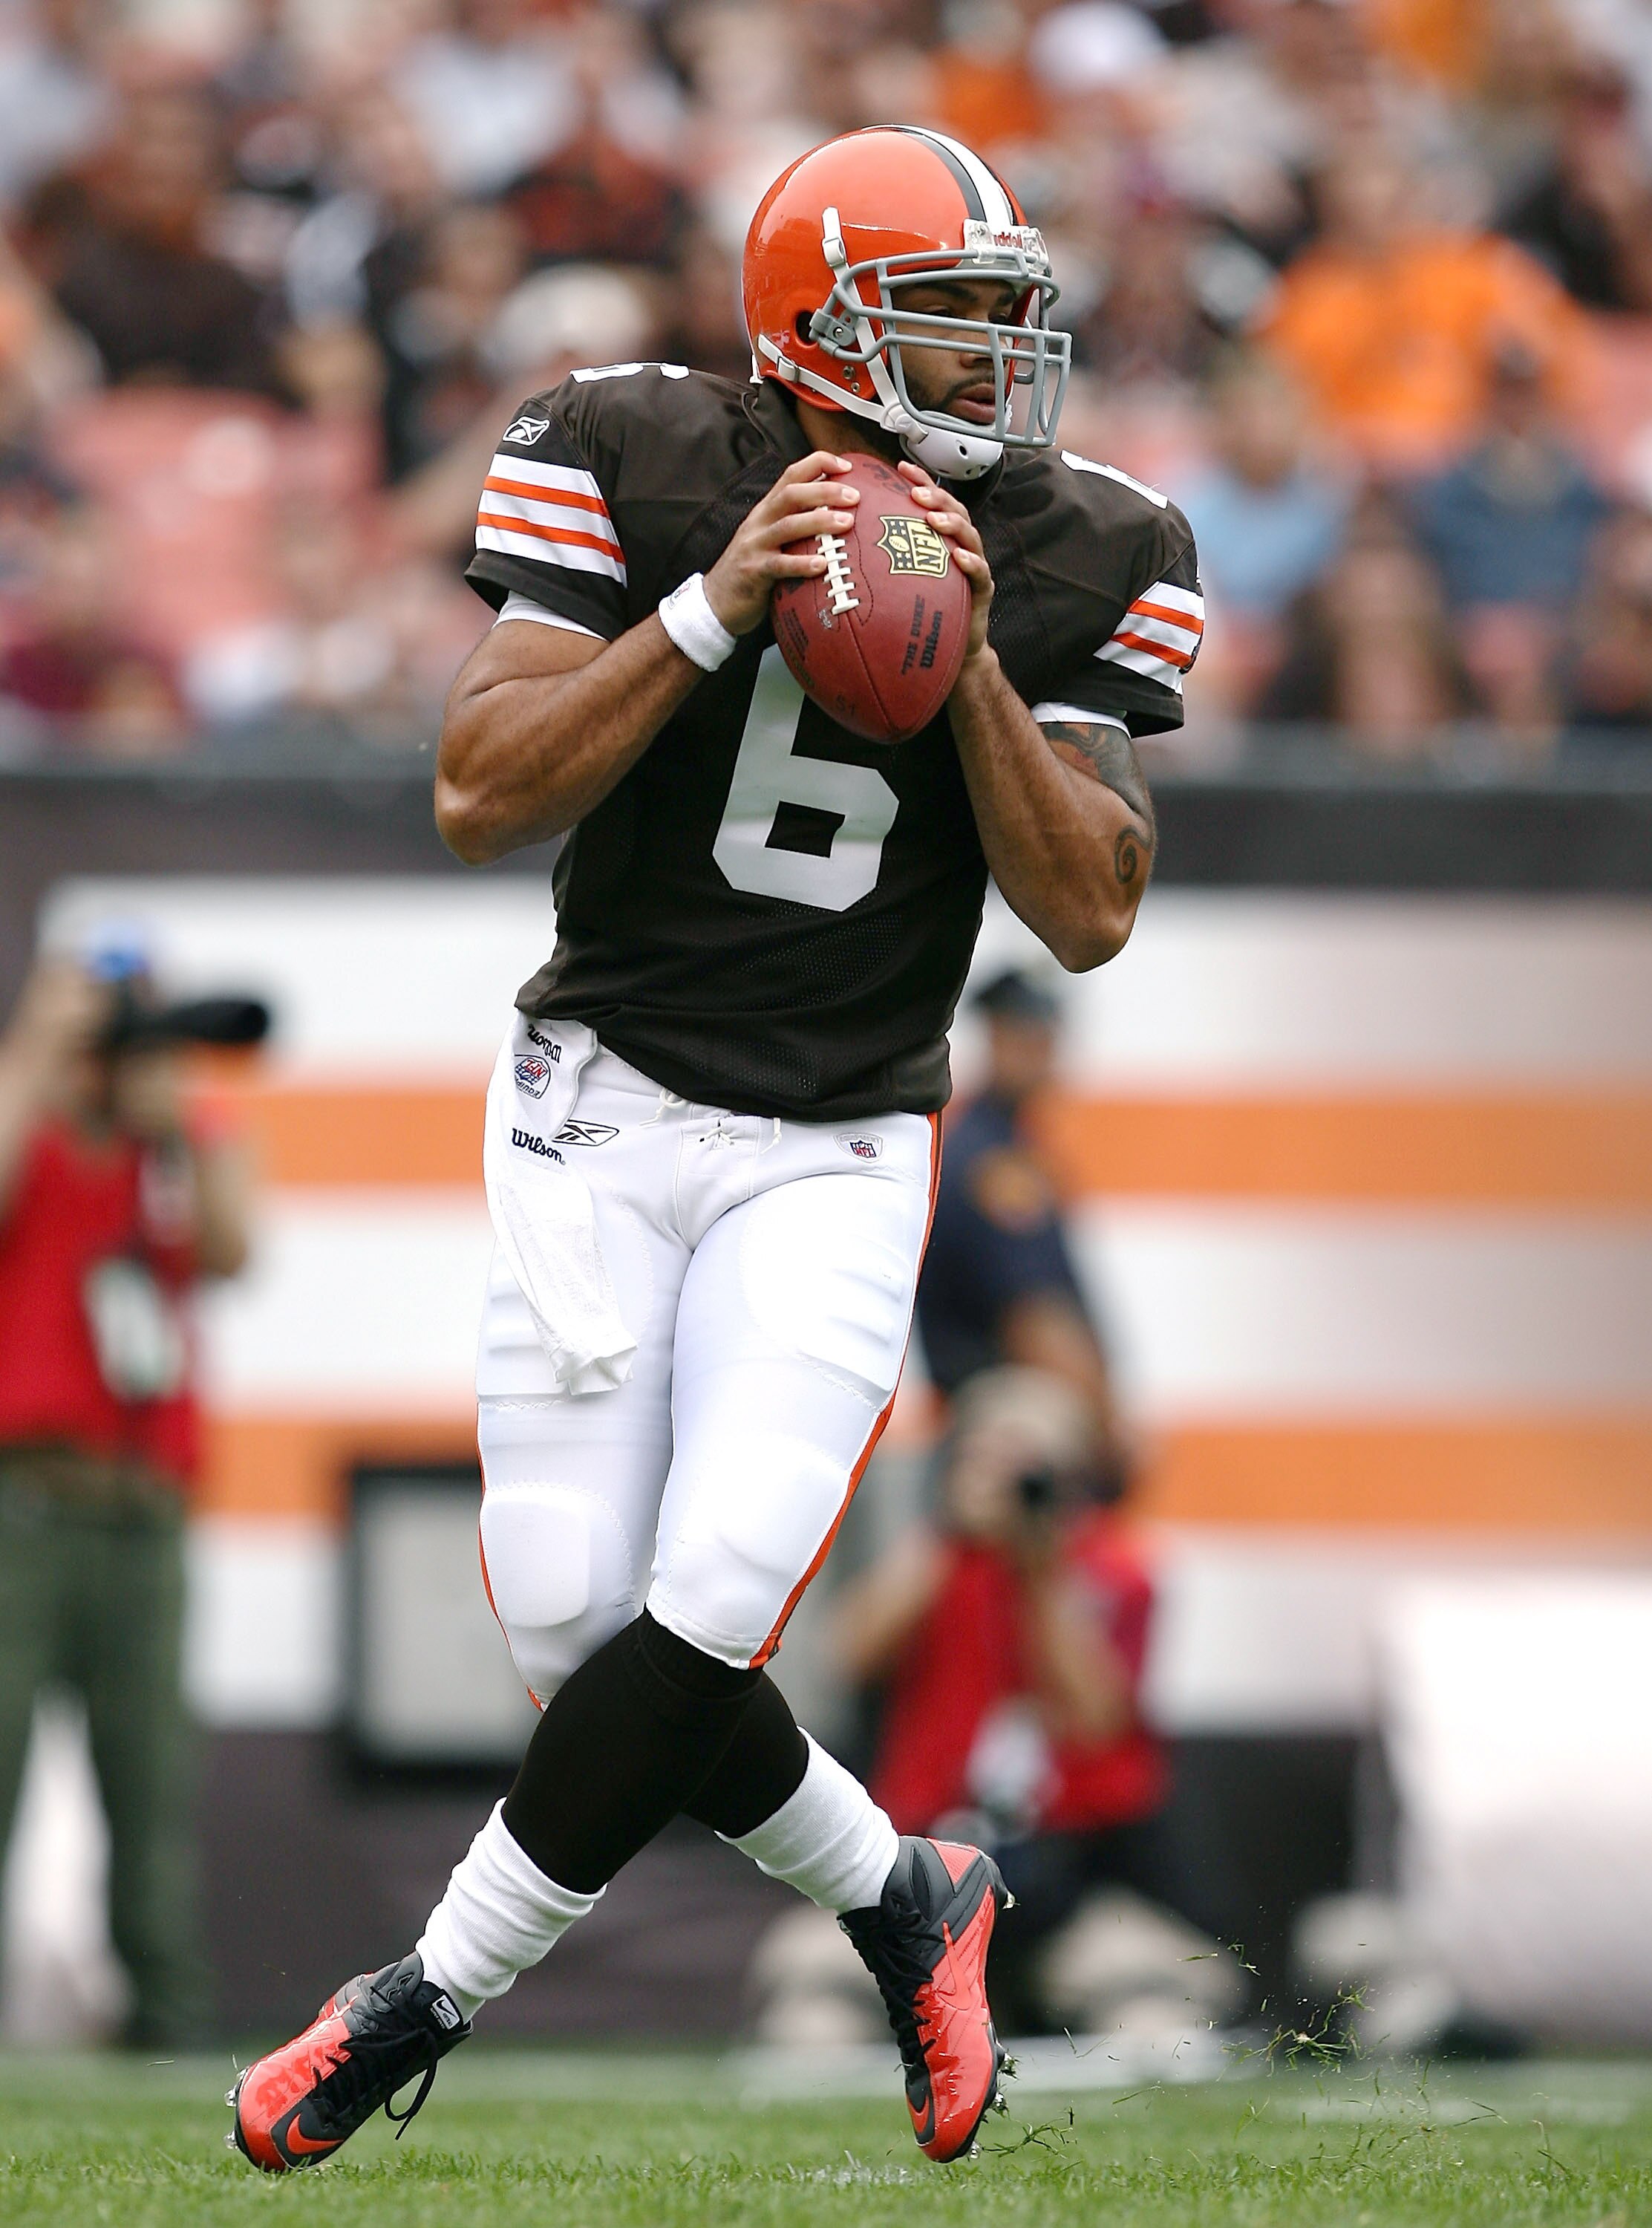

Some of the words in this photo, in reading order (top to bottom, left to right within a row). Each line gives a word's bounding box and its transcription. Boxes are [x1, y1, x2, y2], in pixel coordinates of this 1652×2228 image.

[911, 524, 943, 570] NFL
[920, 610, 942, 668] Wilson
[712, 642, 900, 912] 6
[527, 1023, 562, 1064] Wilson
[523, 1059, 546, 1080] NFL
[512, 1127, 564, 1164] Wilson
